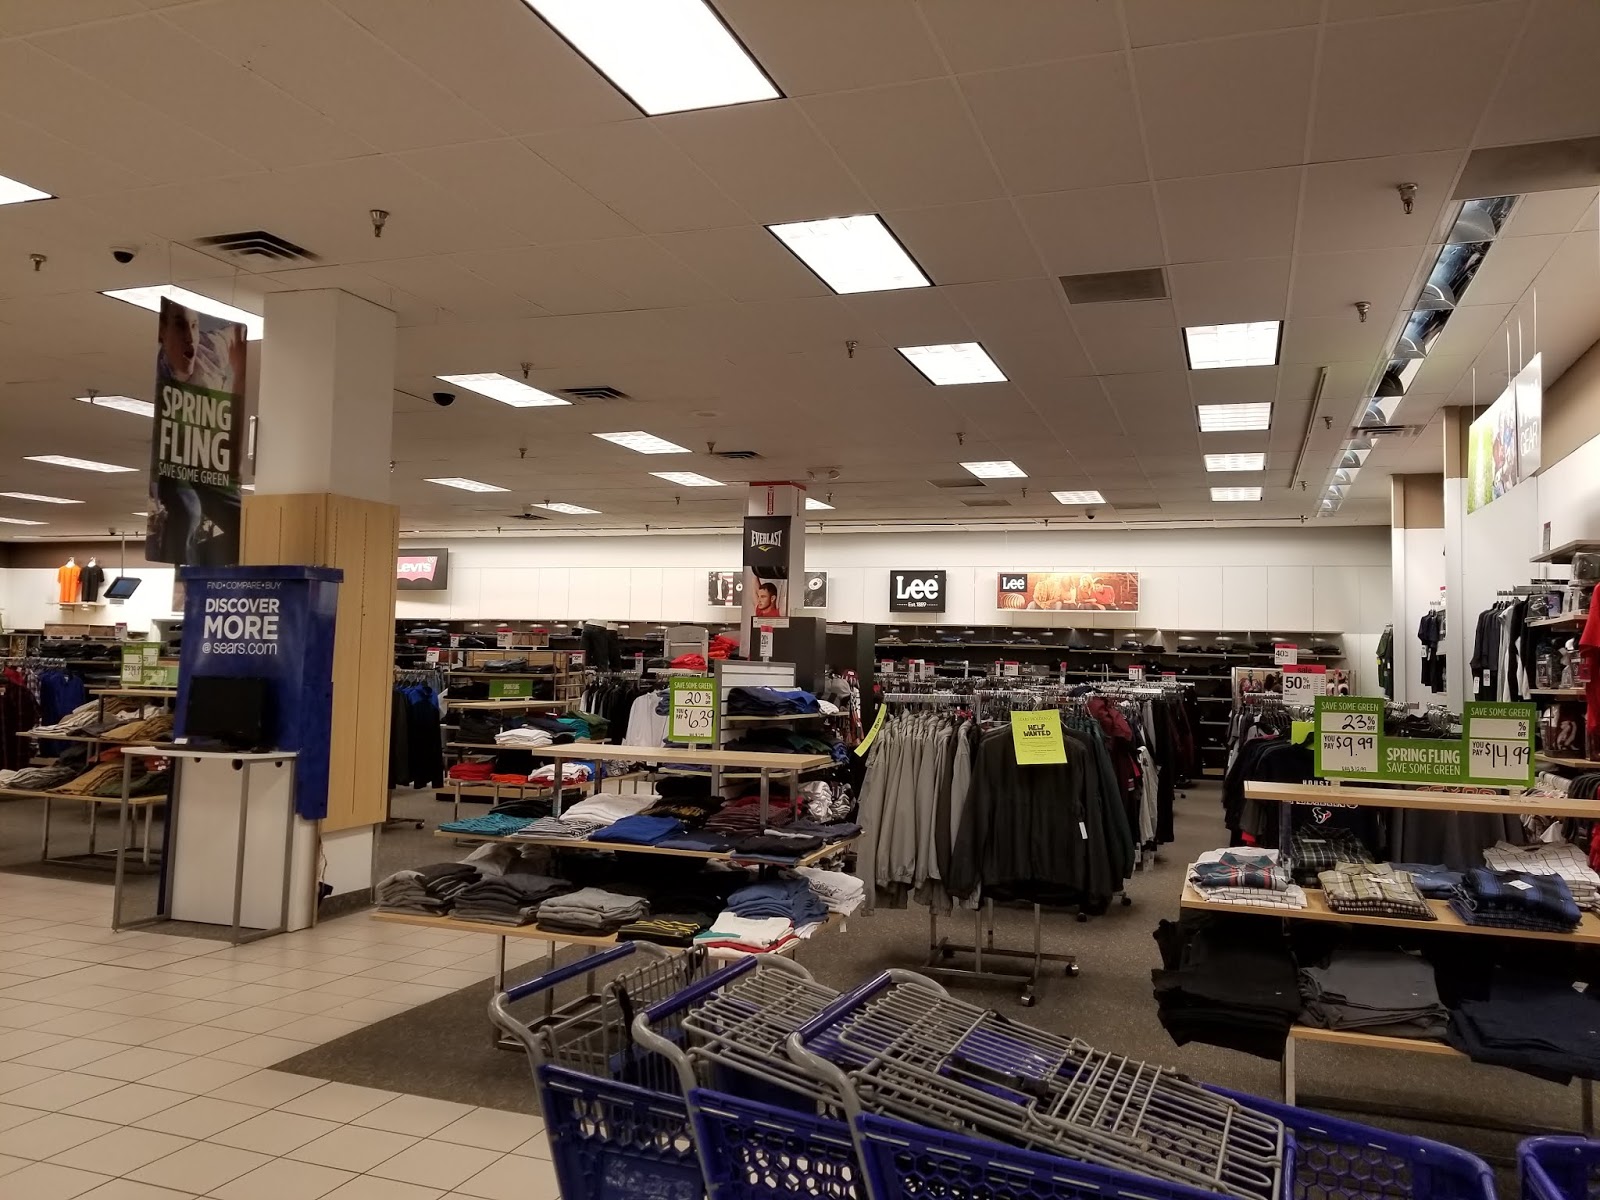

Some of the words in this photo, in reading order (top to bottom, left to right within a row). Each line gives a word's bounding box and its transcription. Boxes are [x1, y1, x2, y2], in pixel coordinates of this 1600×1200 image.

[161, 385, 231, 431] SPRING
[160, 418, 230, 472] FLING
[1521, 421, 1538, 456] GEAR
[158, 462, 175, 478] SAVE
[176, 466, 199, 483] SOME
[201, 471, 229, 486] GREEN
[751, 530, 782, 547] EVERLAST
[896, 576, 939, 600] Lee
[1002, 577, 1025, 590] Lee
[205, 598, 280, 613] DISCOVER
[203, 615, 279, 640] MORE
[213, 642, 277, 655] sears.com
[1321, 702, 1337, 710] SAVE
[1339, 702, 1356, 711] SOME
[1358, 703, 1379, 711] GREEN
[1471, 707, 1488, 716] SAVE
[1489, 708, 1508, 716] SOME
[1509, 708, 1530, 717] GREEN
[1518, 722, 1526, 731] %
[1387, 747, 1427, 762] SPRING
[1428, 749, 1460, 764] FLING
[1387, 762, 1407, 773] SAVE
[1409, 763, 1432, 774] SOME
[1433, 764, 1460, 776] GREEN
